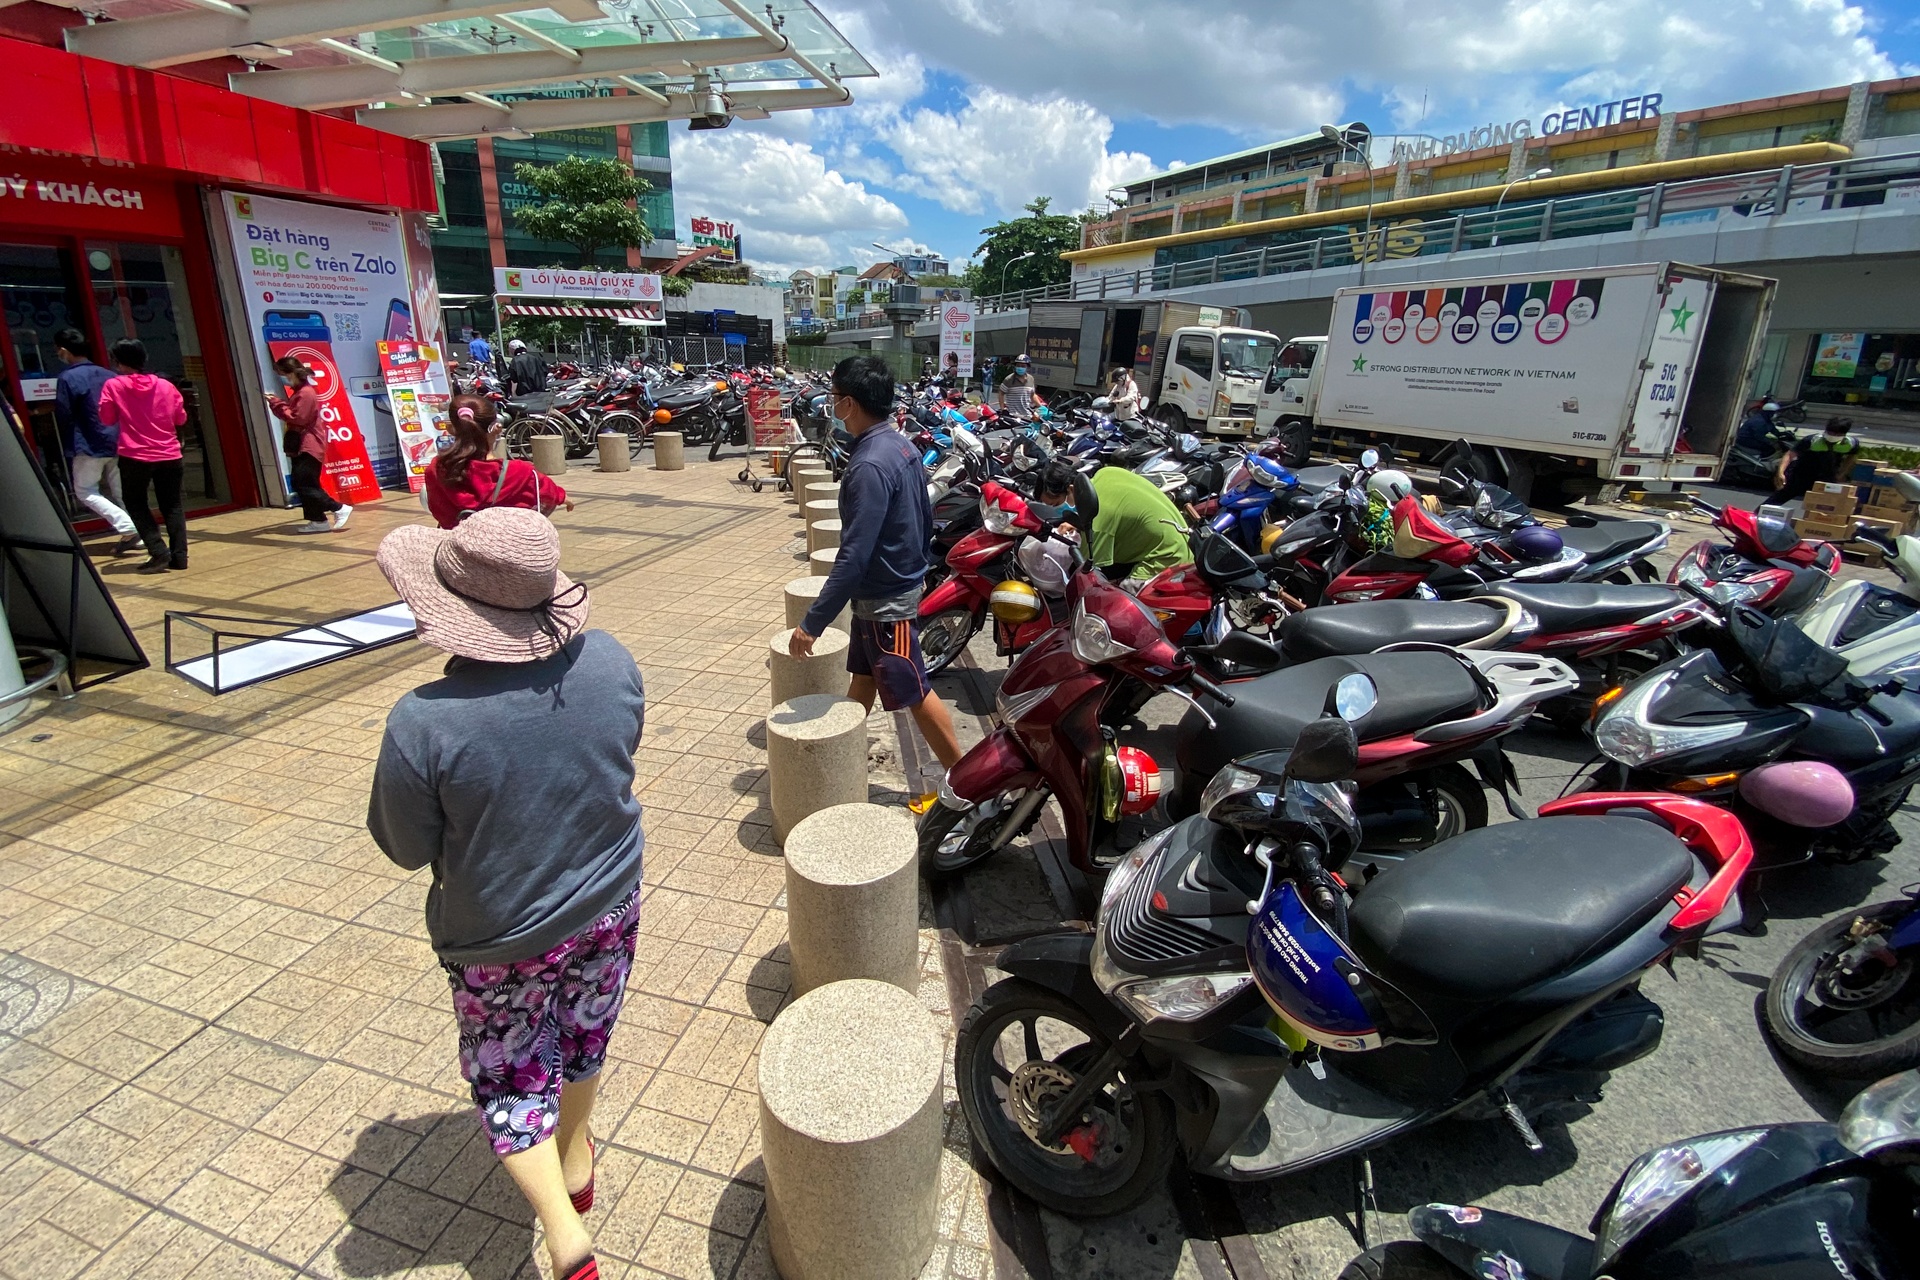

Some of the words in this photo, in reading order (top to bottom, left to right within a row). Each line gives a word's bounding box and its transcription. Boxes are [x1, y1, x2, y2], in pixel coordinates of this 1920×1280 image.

[1541, 92, 1664, 137] CENTER
[0, 173, 28, 199] Ý
[36, 180, 144, 210] KHÁCH
[368, 220, 391, 228] CENTRAL
[691, 216, 715, 235] BẾP
[246, 224, 282, 245] Đặt
[286, 228, 330, 251] hàng
[251, 247, 289, 273] Big
[295, 251, 311, 270] C
[315, 256, 349, 273] trên
[351, 252, 397, 276] Zalo
[531, 271, 550, 284] LỐI
[553, 273, 576, 285] VÀO
[579, 274, 598, 286] BÃI
[600, 276, 620, 287] GIỮ
[621, 278, 635, 288] XE
[271, 331, 282, 339] Big
[1370, 364, 1402, 372] STRONG
[1403, 365, 1462, 375] DISTRIBUTION
[1464, 367, 1511, 377] NETWORK
[1513, 369, 1525, 377] IN
[1527, 370, 1577, 380] VIETNAM
[1660, 363, 1678, 381] 51C
[1650, 383, 1676, 402] 873.04
[320, 403, 342, 423] ỐI
[326, 425, 353, 443] ÀO
[1571, 431, 1607, 442] 51C-87304
[339, 475, 360, 487] 2m
[1804, 528, 1832, 538] HARIBO
[1702, 674, 1731, 695] HONDA
[1280, 950, 1291, 963] CAO
